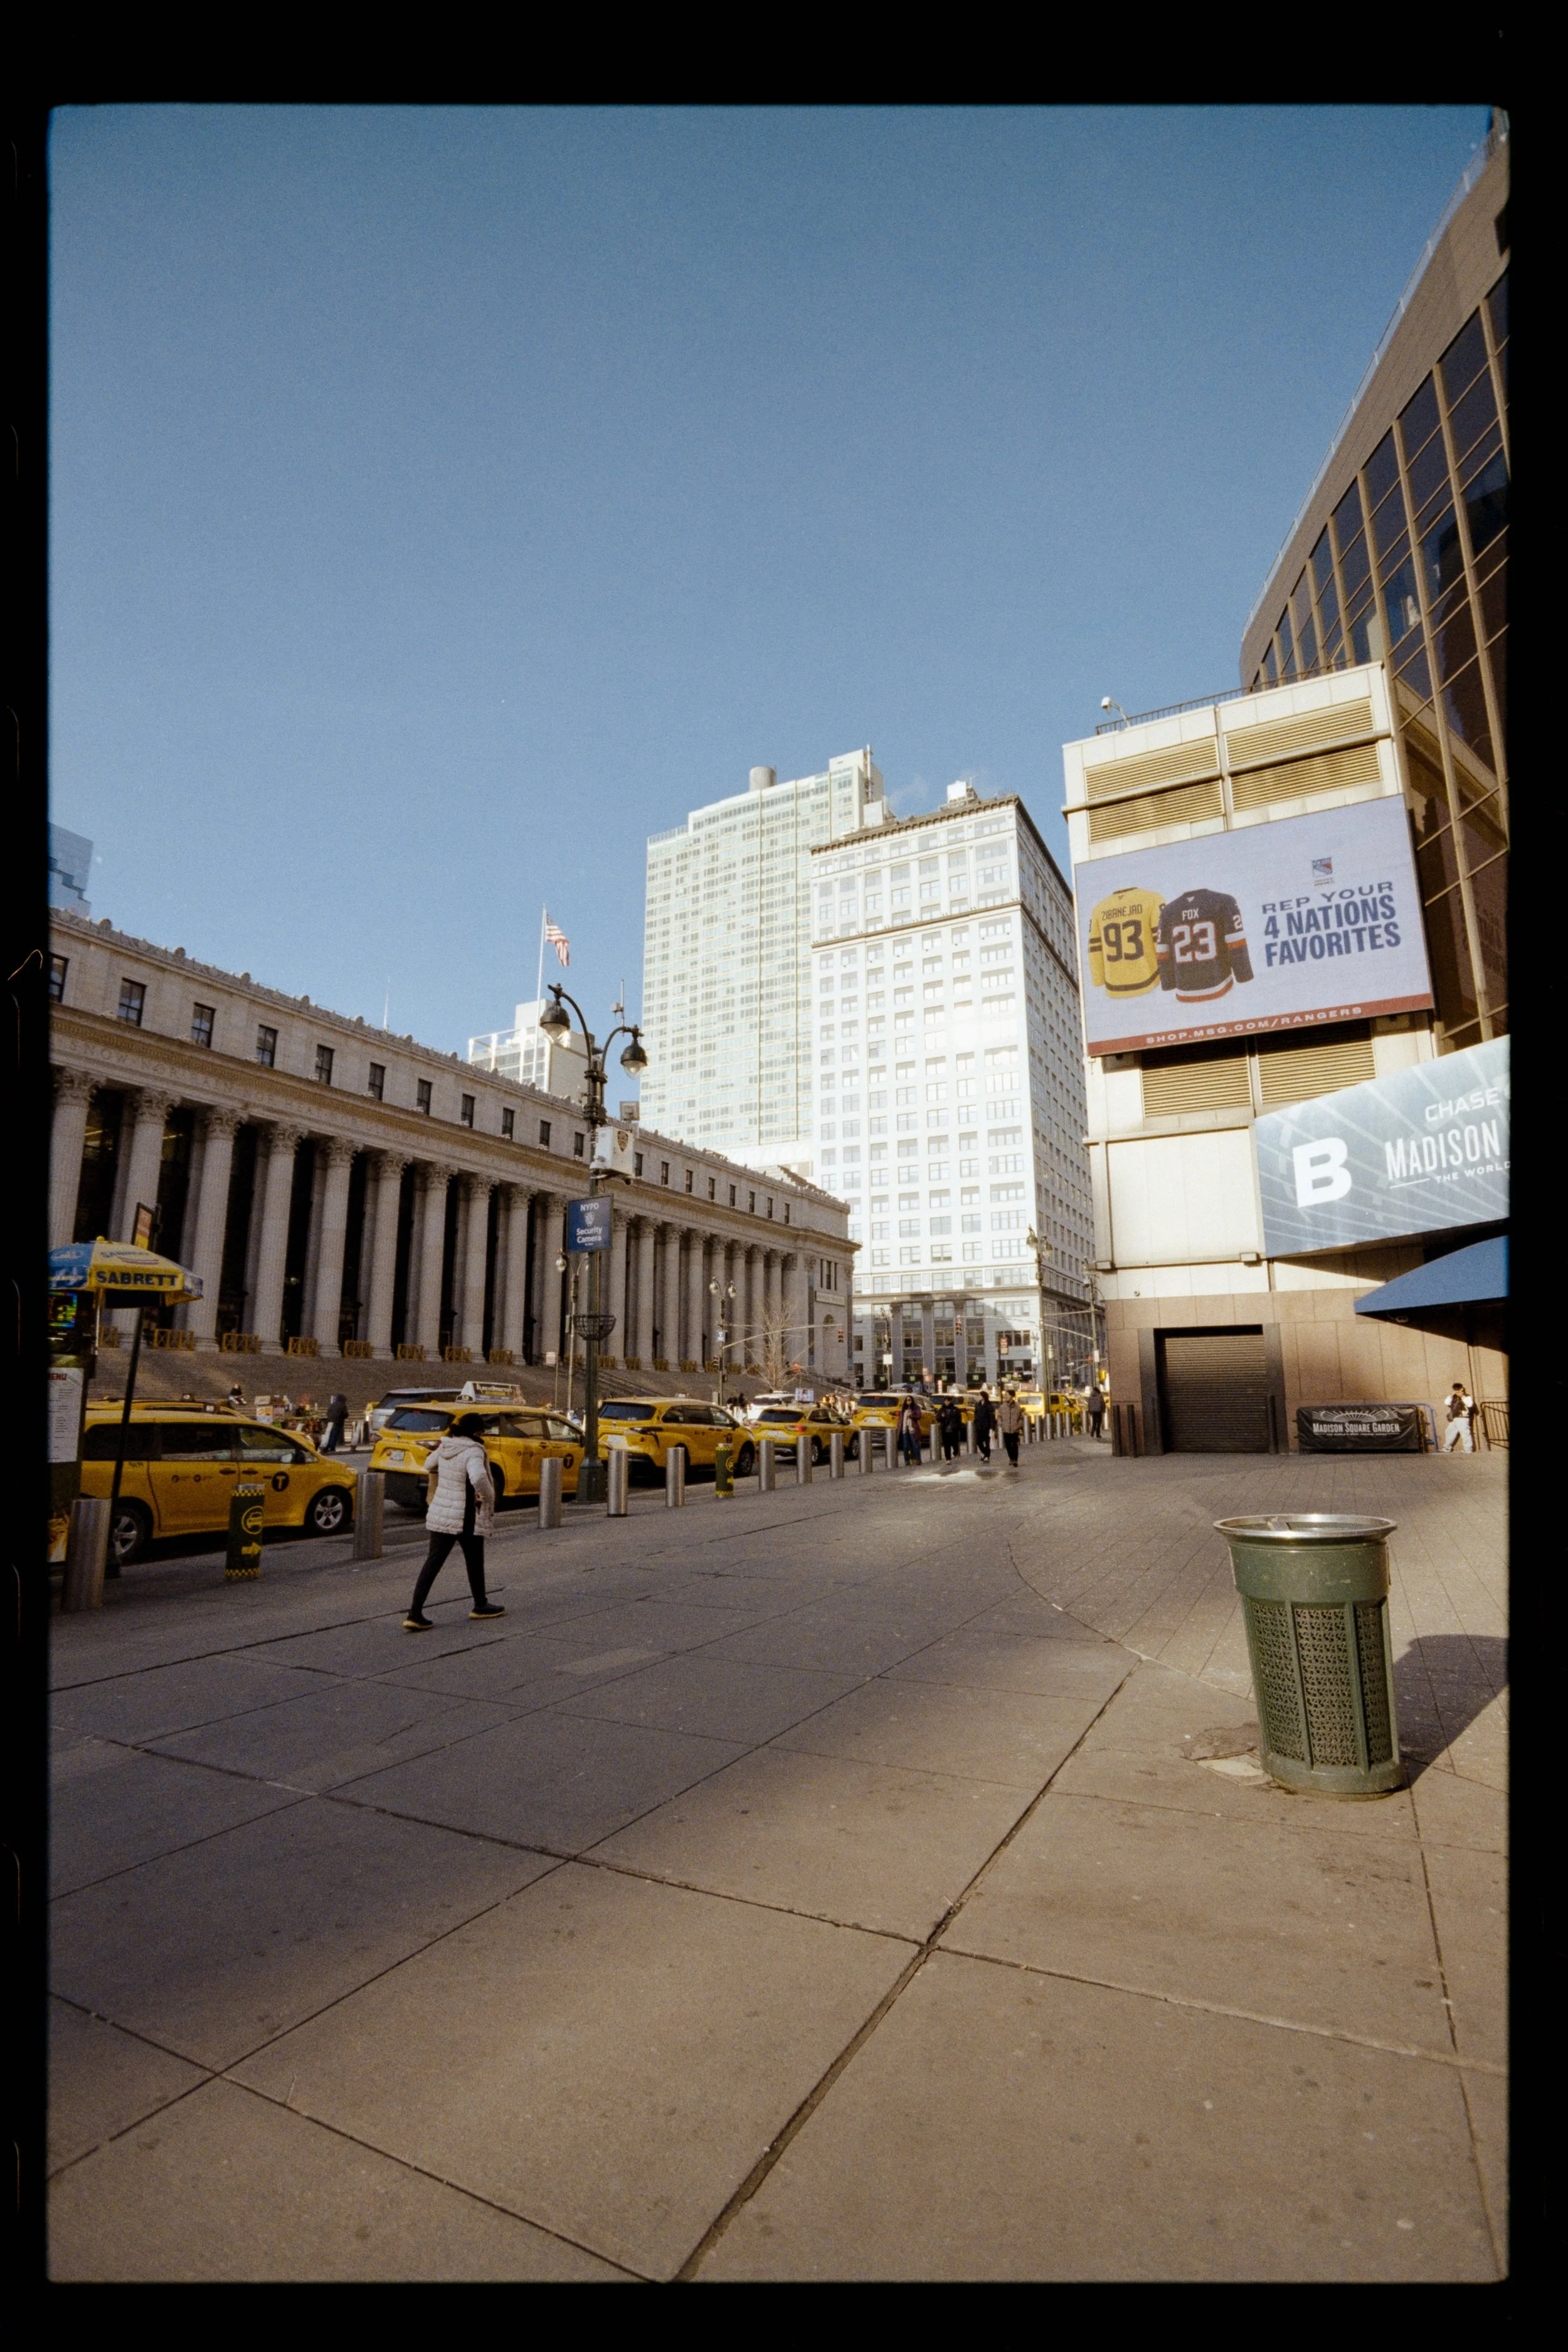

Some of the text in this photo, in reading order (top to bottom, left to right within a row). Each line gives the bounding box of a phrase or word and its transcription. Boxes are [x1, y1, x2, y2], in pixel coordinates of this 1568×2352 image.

[1262, 897, 1310, 914] REP
[1320, 881, 1393, 903] YOUR
[1101, 904, 1143, 921] ZIBANEJAD
[1182, 908, 1199, 921] FOX
[1264, 894, 1396, 939] 4 NATIONS
[1103, 919, 1144, 962] 93
[1172, 921, 1217, 963] 23
[1265, 921, 1401, 967] FAVORITES
[1147, 1007, 1362, 1044] SHOP.MSG.COM/RANGERS
[1425, 1087, 1500, 1121] CHASE
[1384, 1119, 1501, 1180] MADISON
[1292, 1136, 1353, 1208] B
[1435, 1172, 1459, 1184] THE
[580, 1202, 599, 1211] NYPD
[576, 1226, 602, 1235] Security
[577, 1236, 601, 1244] Camera
[96, 1271, 178, 1286] SABRETT
[1313, 1422, 1343, 1433] MADISON
[1345, 1422, 1370, 1433] SQUARE
[276, 1475, 286, 1489] T
